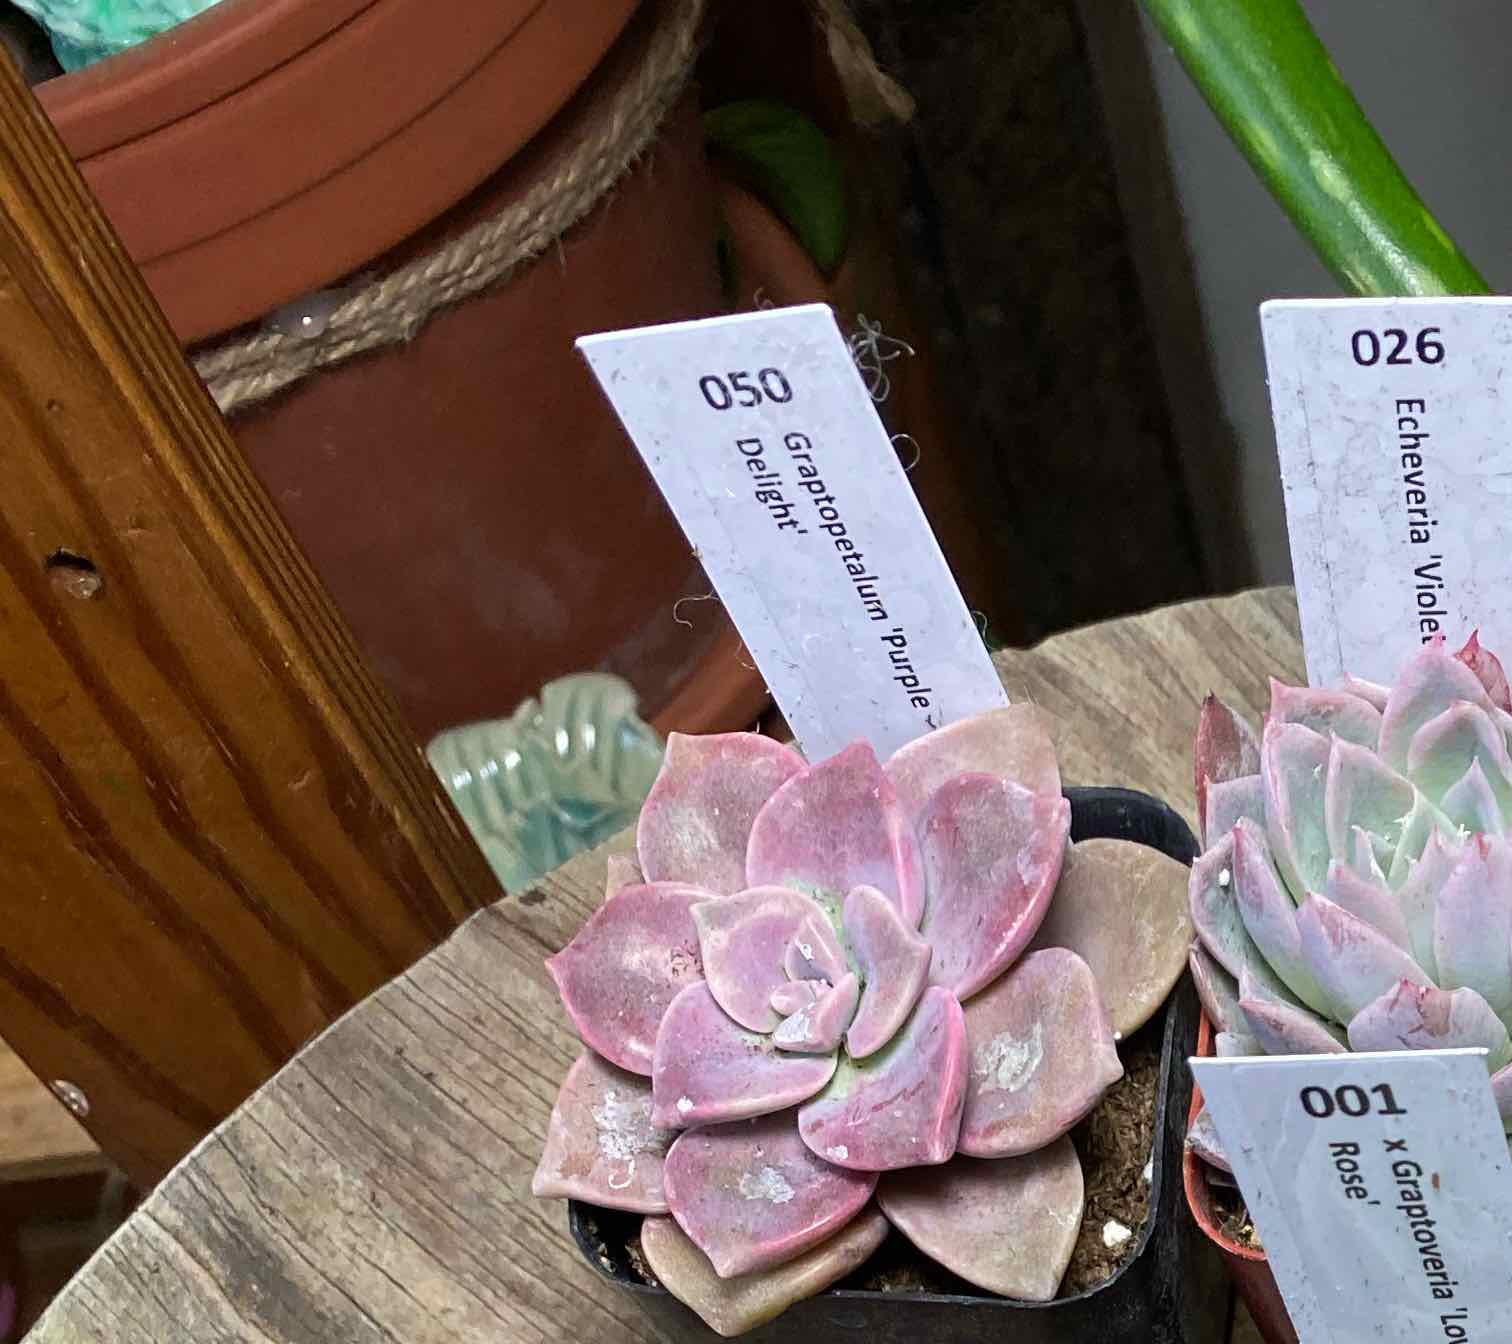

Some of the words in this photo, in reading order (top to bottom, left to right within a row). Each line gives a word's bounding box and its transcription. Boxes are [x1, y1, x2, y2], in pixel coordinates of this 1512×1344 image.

[1351, 327, 1445, 366] 026
[699, 368, 793, 411] 050
[736, 436, 807, 535] Delight'
[1396, 398, 1438, 545] Echeveria
[783, 431, 888, 621] Graptopetalum
[880, 627, 930, 708] 'Purple
[1299, 1083, 1407, 1118] 001
[1329, 1140, 1381, 1206] Rose'
[1392, 1159, 1457, 1300] Graptoveria
